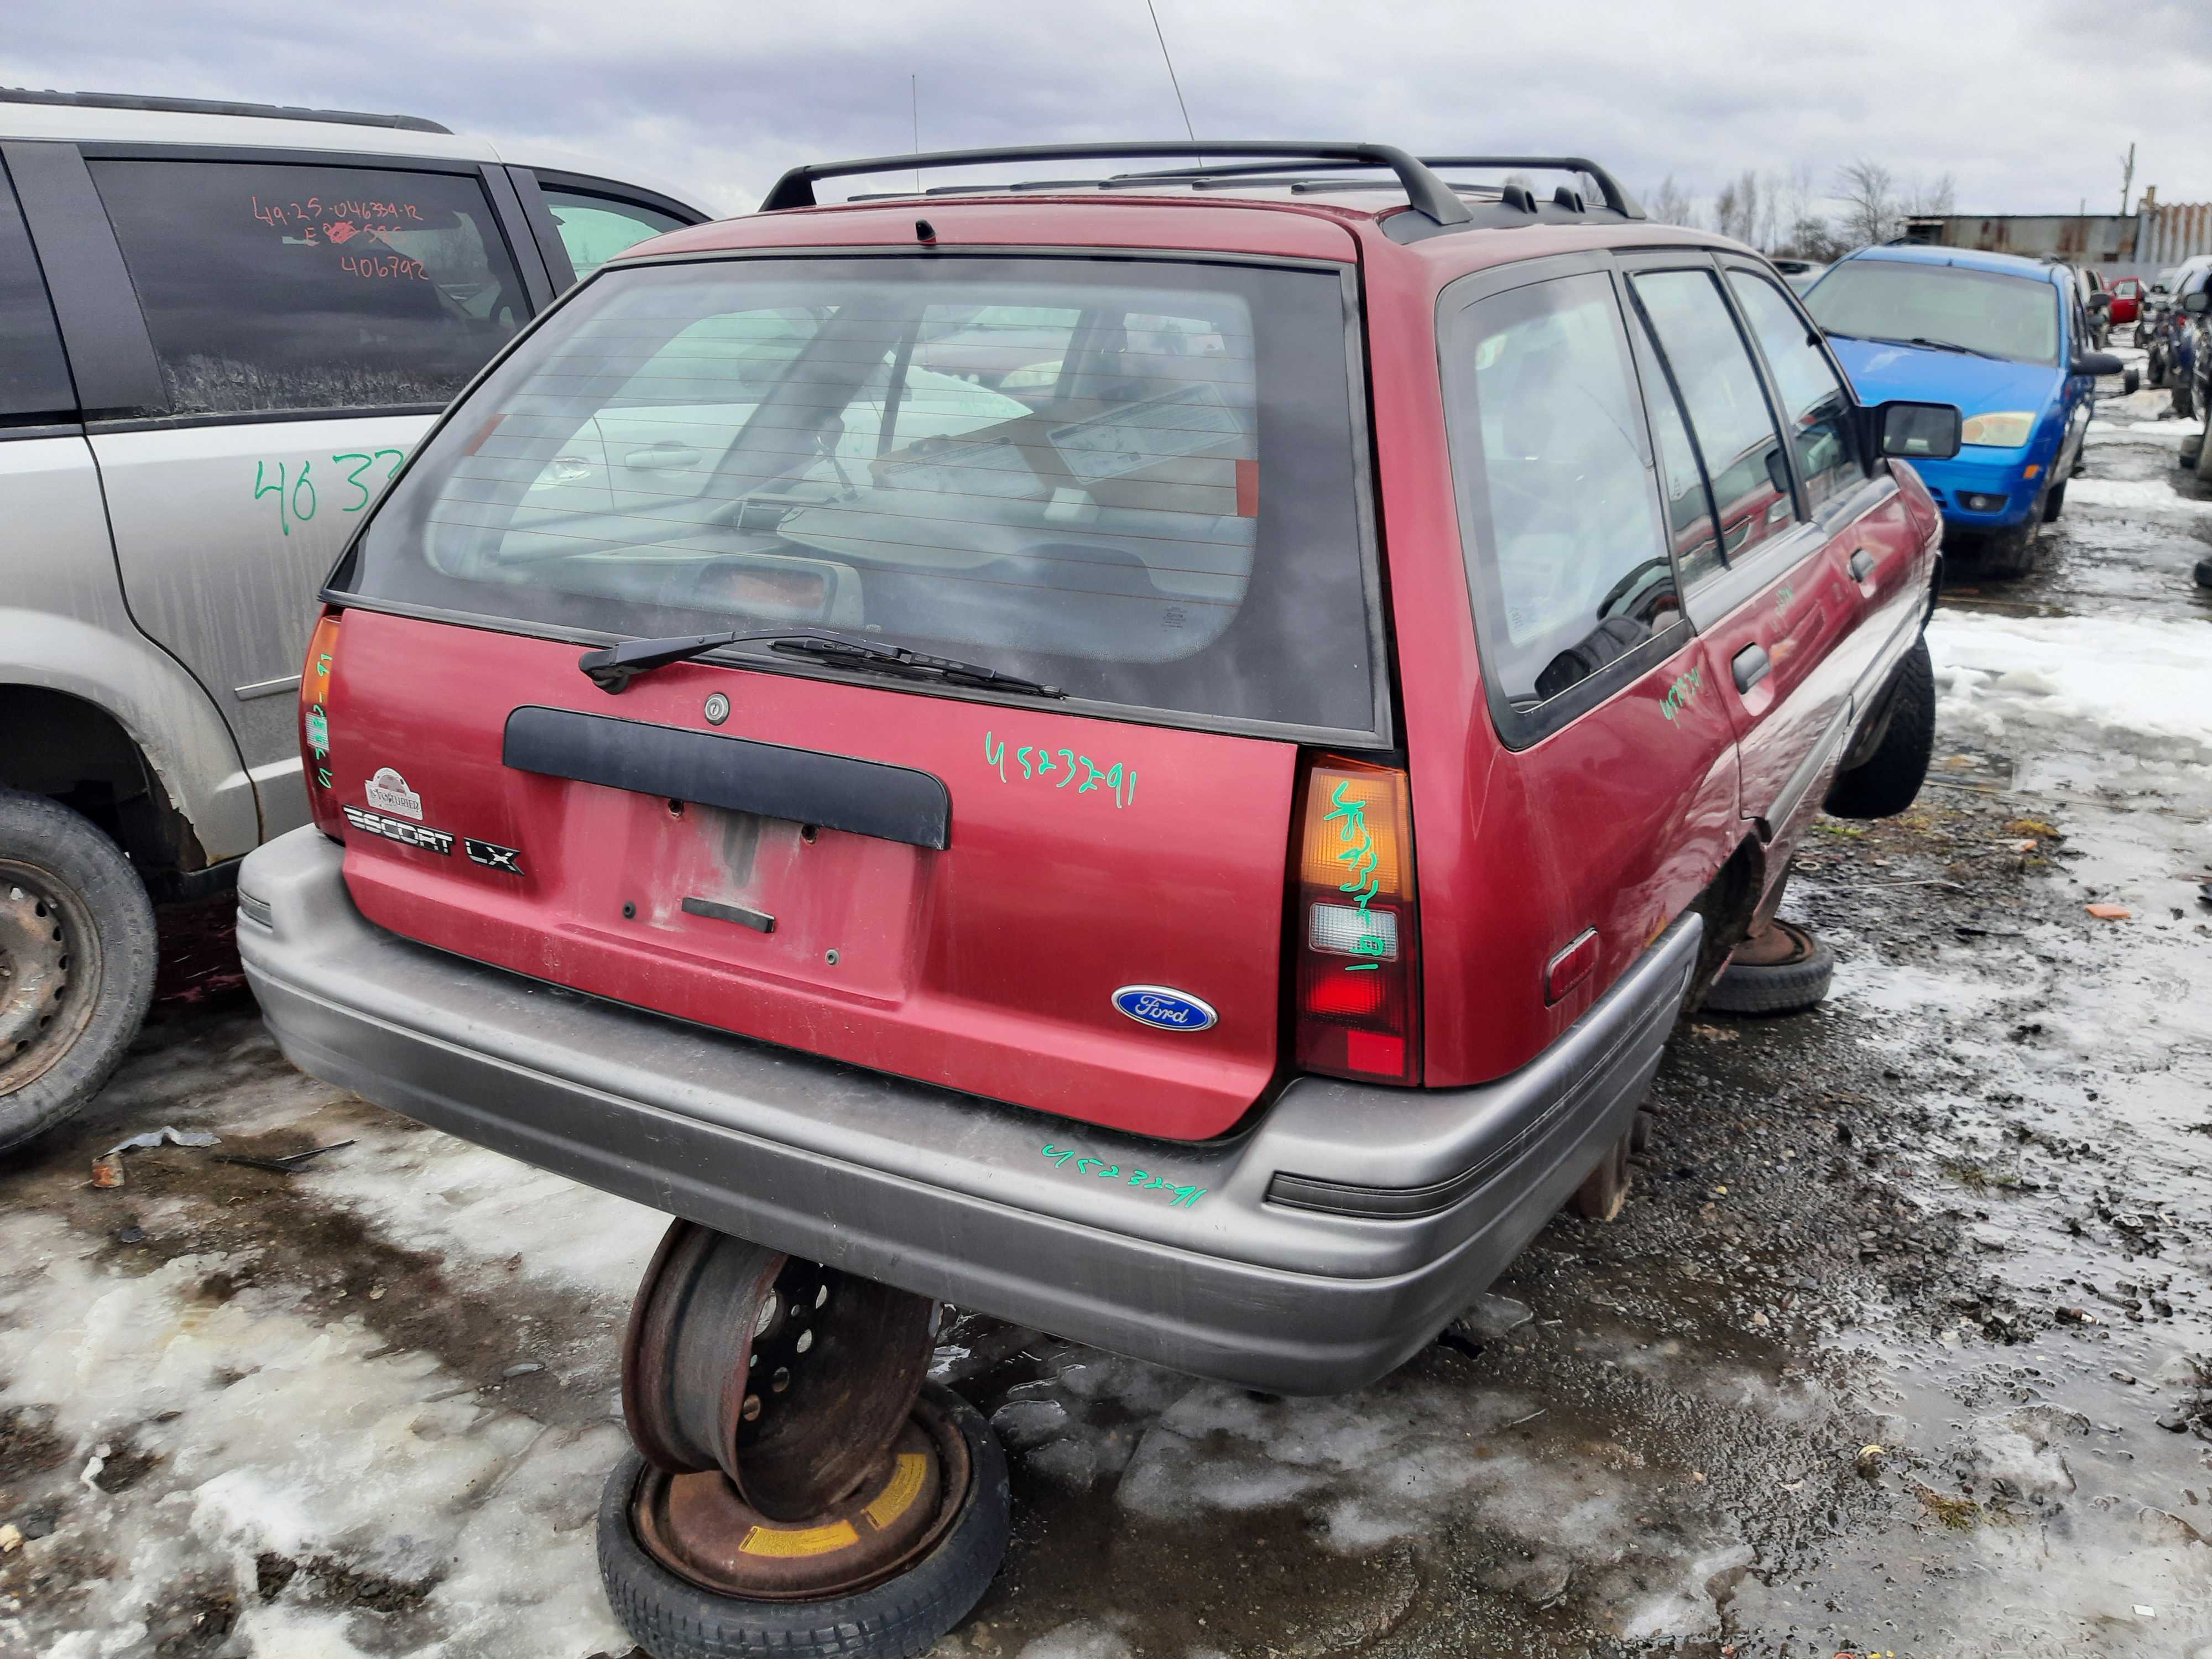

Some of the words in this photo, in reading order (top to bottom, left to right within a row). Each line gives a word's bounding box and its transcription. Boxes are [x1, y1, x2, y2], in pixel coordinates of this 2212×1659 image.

[342, 805, 453, 854] ESCORT
[465, 840, 518, 873] LX
[1135, 995, 1189, 1023] Ford
